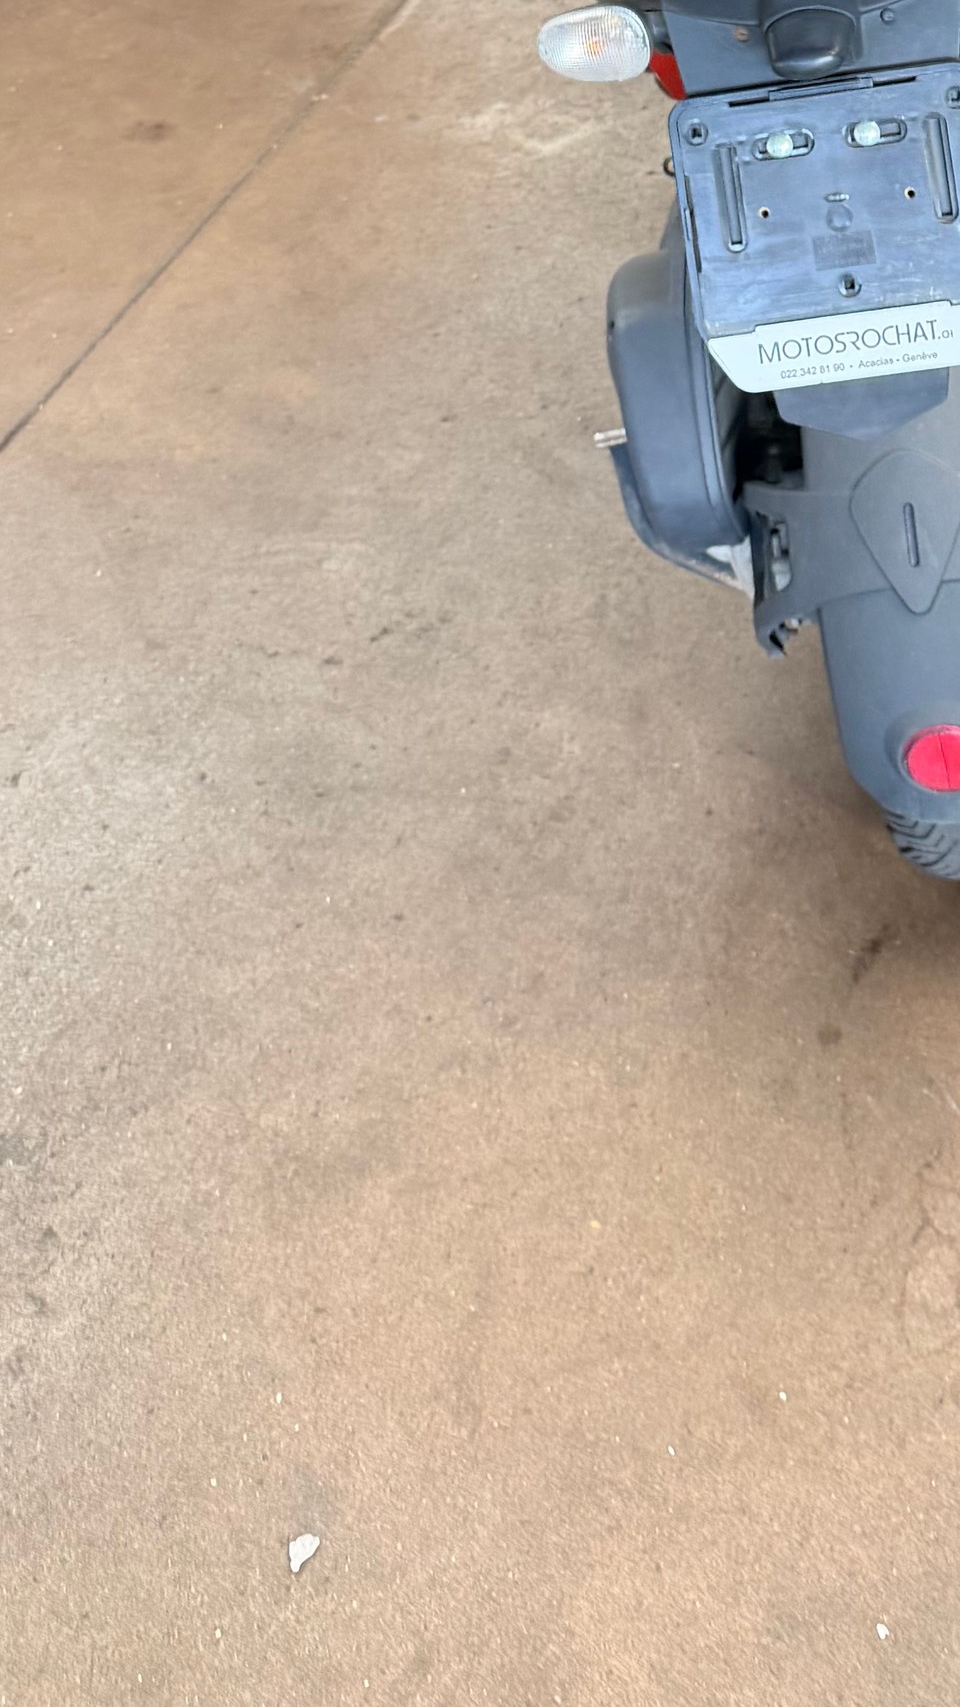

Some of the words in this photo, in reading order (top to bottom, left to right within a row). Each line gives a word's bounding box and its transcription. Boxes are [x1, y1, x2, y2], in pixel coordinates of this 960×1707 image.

[780, 369, 797, 379] 022
[799, 366, 817, 377] 342
[858, 357, 894, 369] Acacias
[902, 351, 938, 363] Genève
